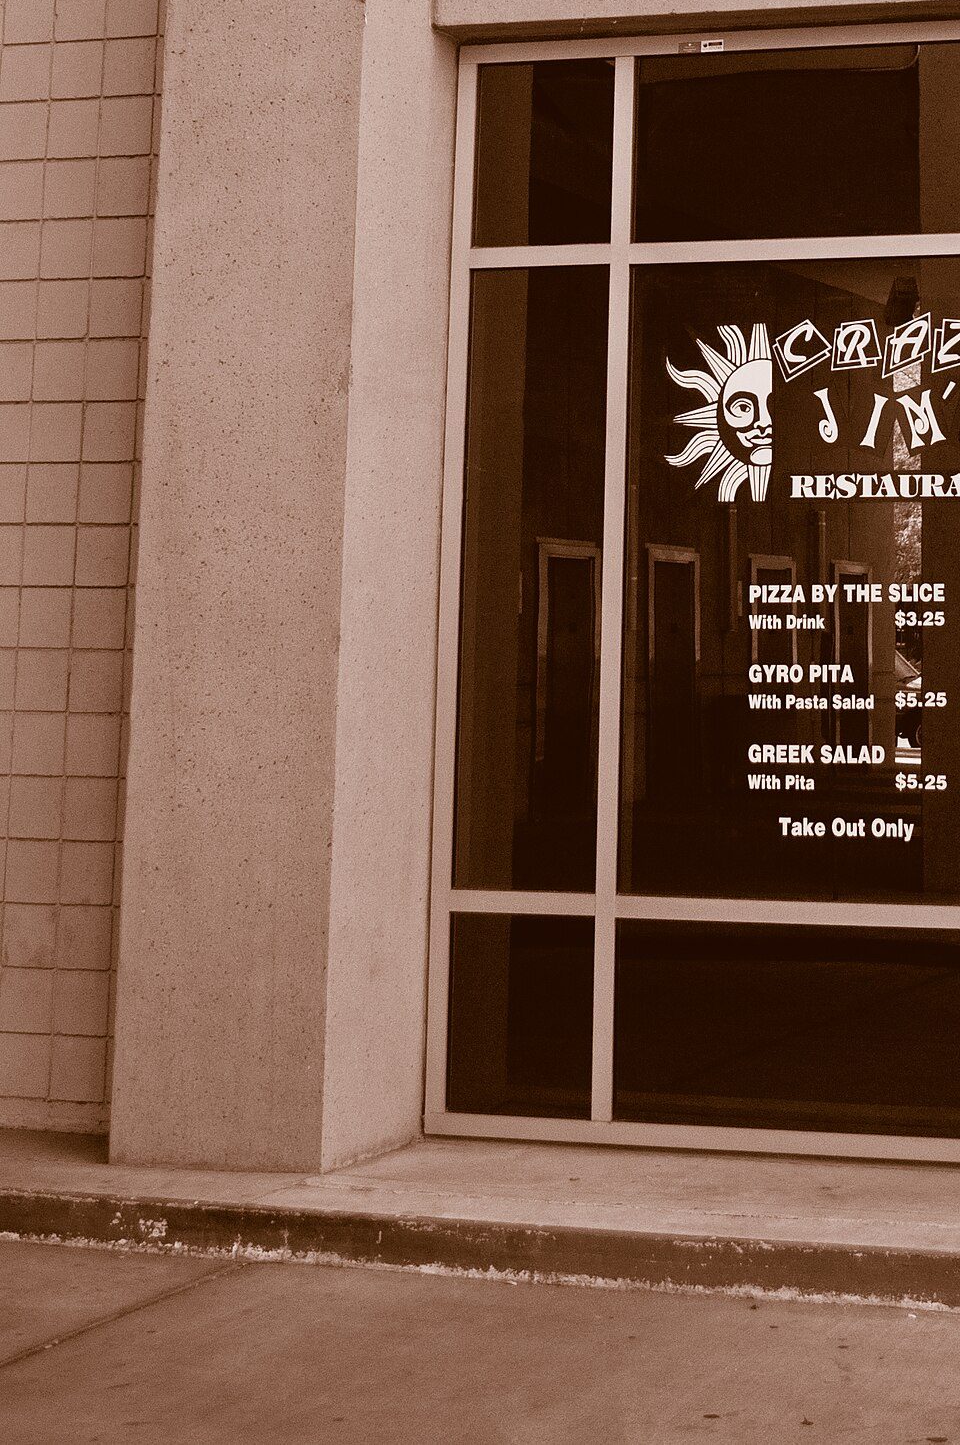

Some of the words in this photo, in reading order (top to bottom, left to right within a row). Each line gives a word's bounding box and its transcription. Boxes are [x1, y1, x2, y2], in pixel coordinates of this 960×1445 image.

[749, 584, 806, 603] PIZZA
[811, 584, 838, 603] BY
[844, 584, 883, 602] THE
[888, 583, 945, 602] SLICE
[749, 614, 782, 630] With
[786, 614, 825, 630] Drink
[894, 610, 946, 628] $3.25
[748, 664, 804, 683] GYRO
[809, 664, 854, 683] PITA
[748, 694, 782, 710] With
[785, 694, 828, 710] Pasta
[832, 694, 875, 710] Salad
[894, 691, 948, 710] $5.25
[747, 744, 815, 764] GREEK
[820, 745, 886, 764] SALAD
[747, 774, 781, 790] With
[785, 774, 815, 791] Pita
[894, 771, 948, 791] $5.25
[778, 817, 826, 837] Take
[831, 817, 866, 837] Out
[871, 818, 915, 842] Only
